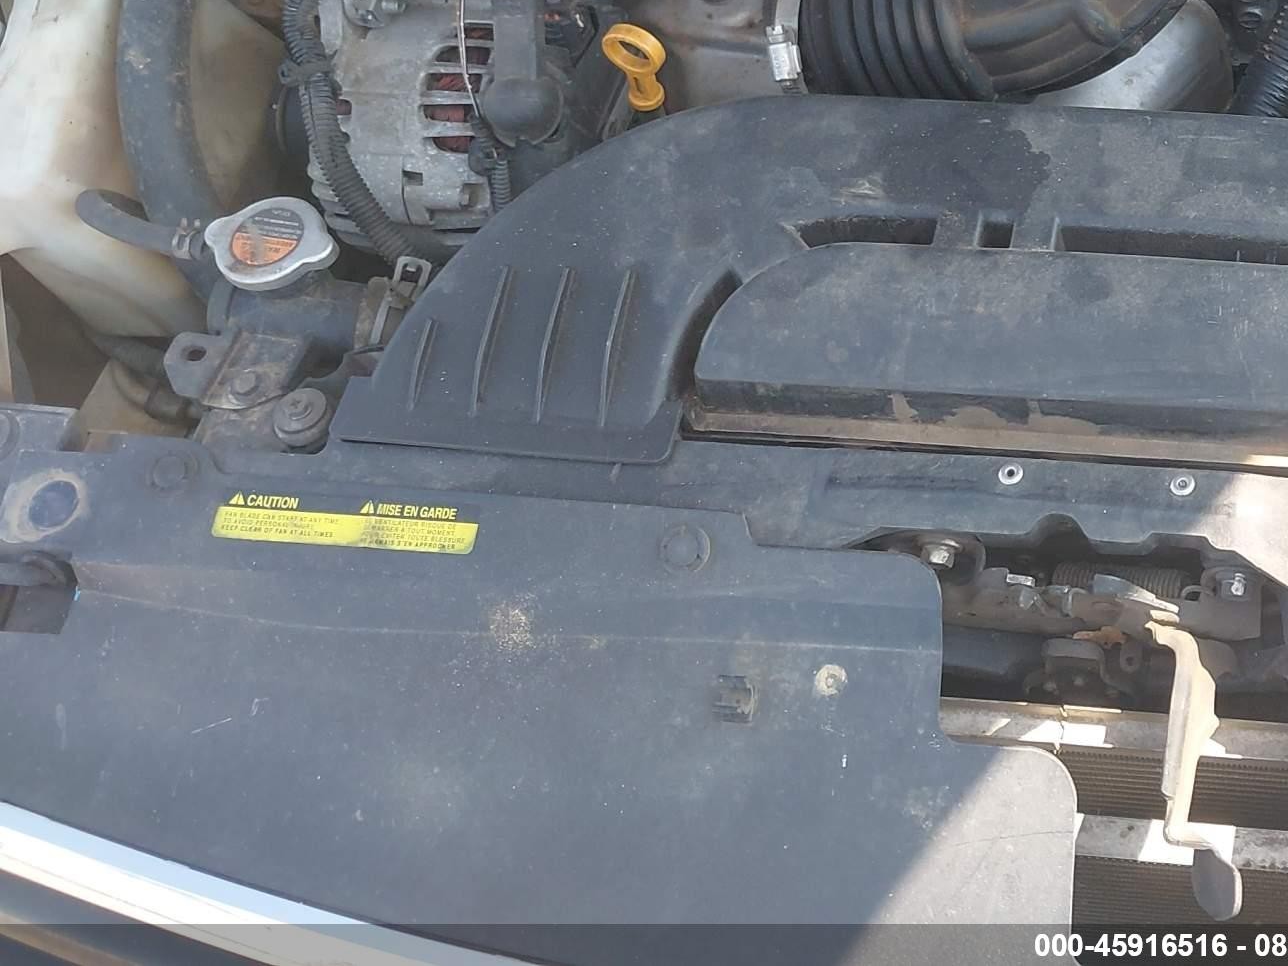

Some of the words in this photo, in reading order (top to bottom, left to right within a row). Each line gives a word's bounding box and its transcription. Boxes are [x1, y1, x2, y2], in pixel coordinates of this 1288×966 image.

[247, 494, 299, 509] CAUTION
[376, 503, 402, 516] MISE
[403, 505, 419, 518] EN
[420, 507, 457, 520] GARDE
